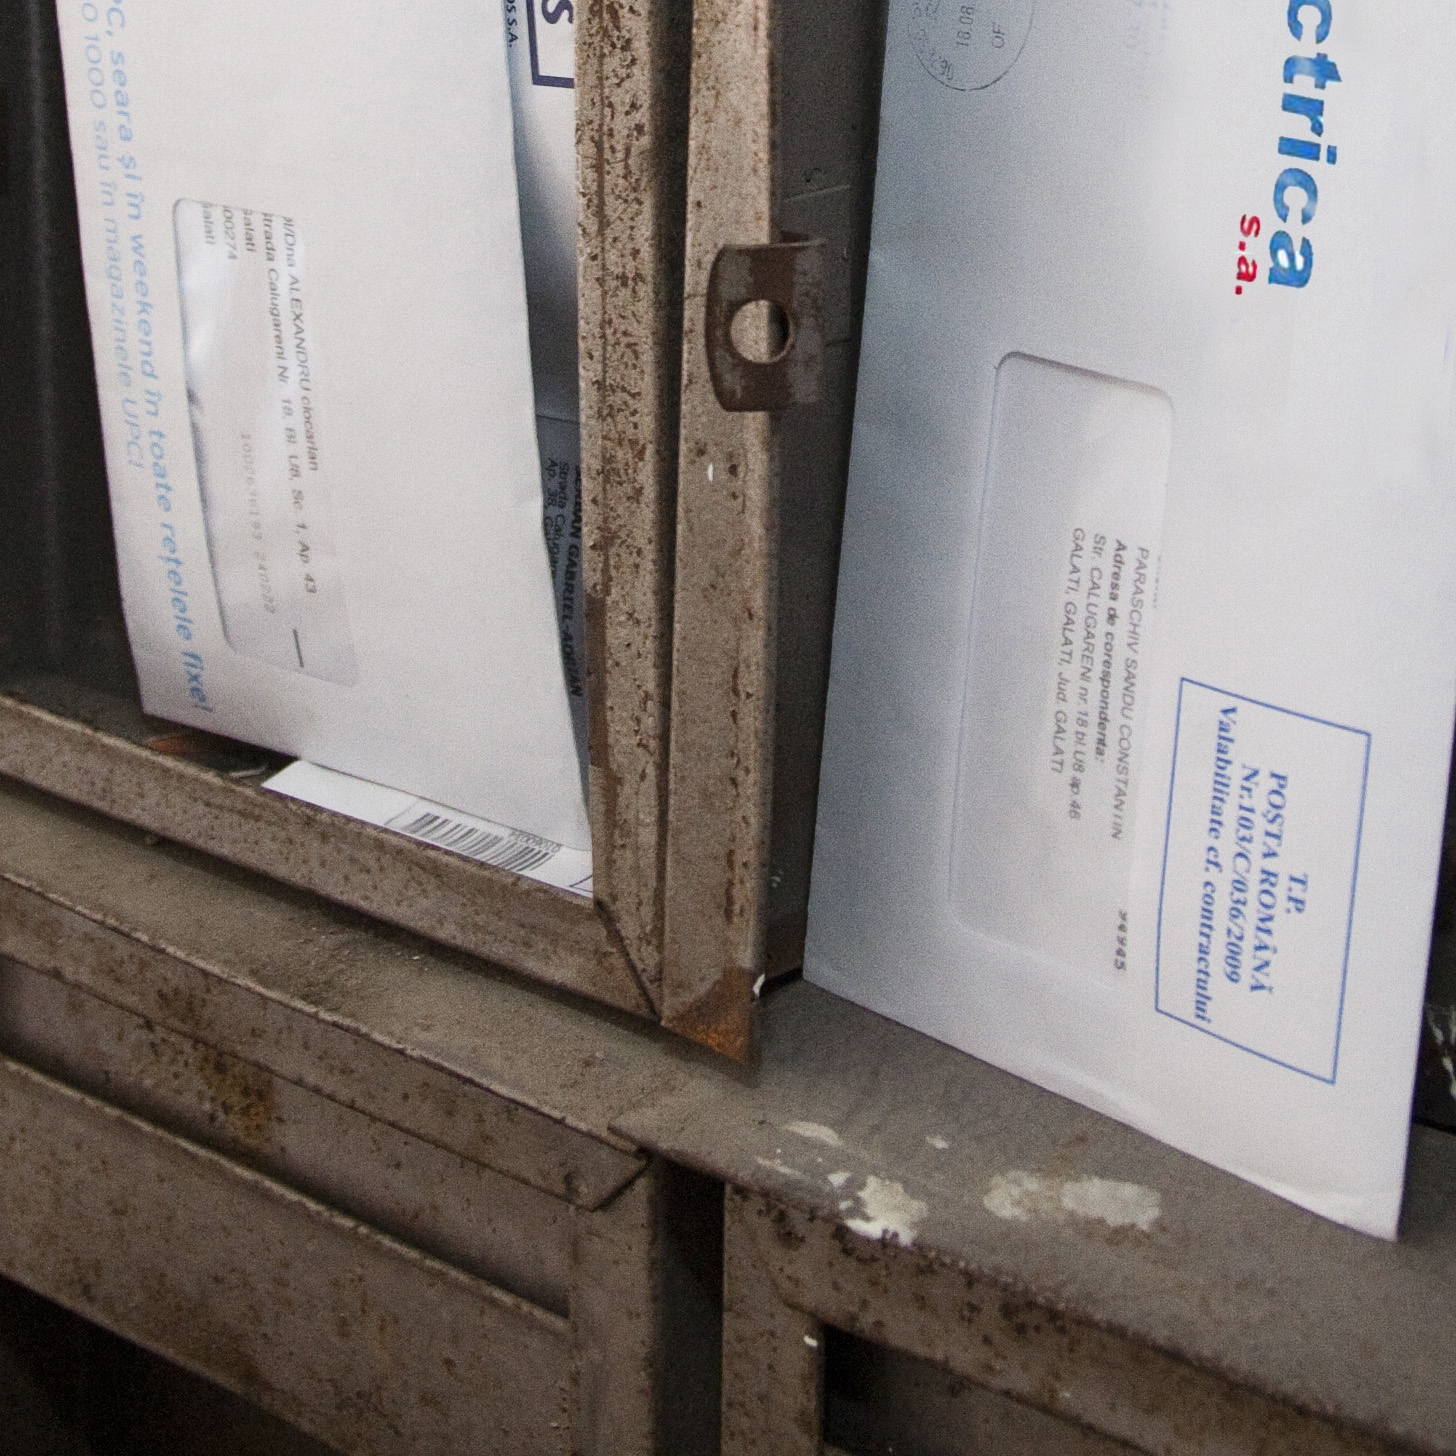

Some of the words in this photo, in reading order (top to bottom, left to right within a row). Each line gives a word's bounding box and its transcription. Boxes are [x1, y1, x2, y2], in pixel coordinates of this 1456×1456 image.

[506, 18, 519, 48] S.A.
[85, 34, 107, 110] 1000
[110, 50, 134, 142] seara
[93, 121, 111, 173] sau
[99, 181, 118, 206] în
[126, 191, 145, 221] în
[222, 205, 238, 261] 00274
[1235, 214, 1260, 295] s.a.
[104, 219, 133, 388] magazinele
[130, 233, 160, 381] weekend
[268, 268, 289, 360] Calugareni
[288, 273, 312, 392] ALEXANDRU
[144, 389, 162, 417] în
[148, 430, 173, 513] toate
[1107, 538, 1128, 601] Adresa
[1126, 546, 1150, 655] PARASCHIV
[1079, 567, 1104, 681] CALUGARENI
[1105, 606, 1120, 626] de
[181, 651, 214, 714] fixe!
[1119, 657, 1140, 720] SANDU
[1050, 709, 1069, 774] GALATI
[1207, 704, 1239, 840] Valabilitate
[1111, 724, 1133, 840] CONSTANTIN
[1284, 872, 1310, 915] T.P.
[1193, 880, 1220, 1024] contractului
